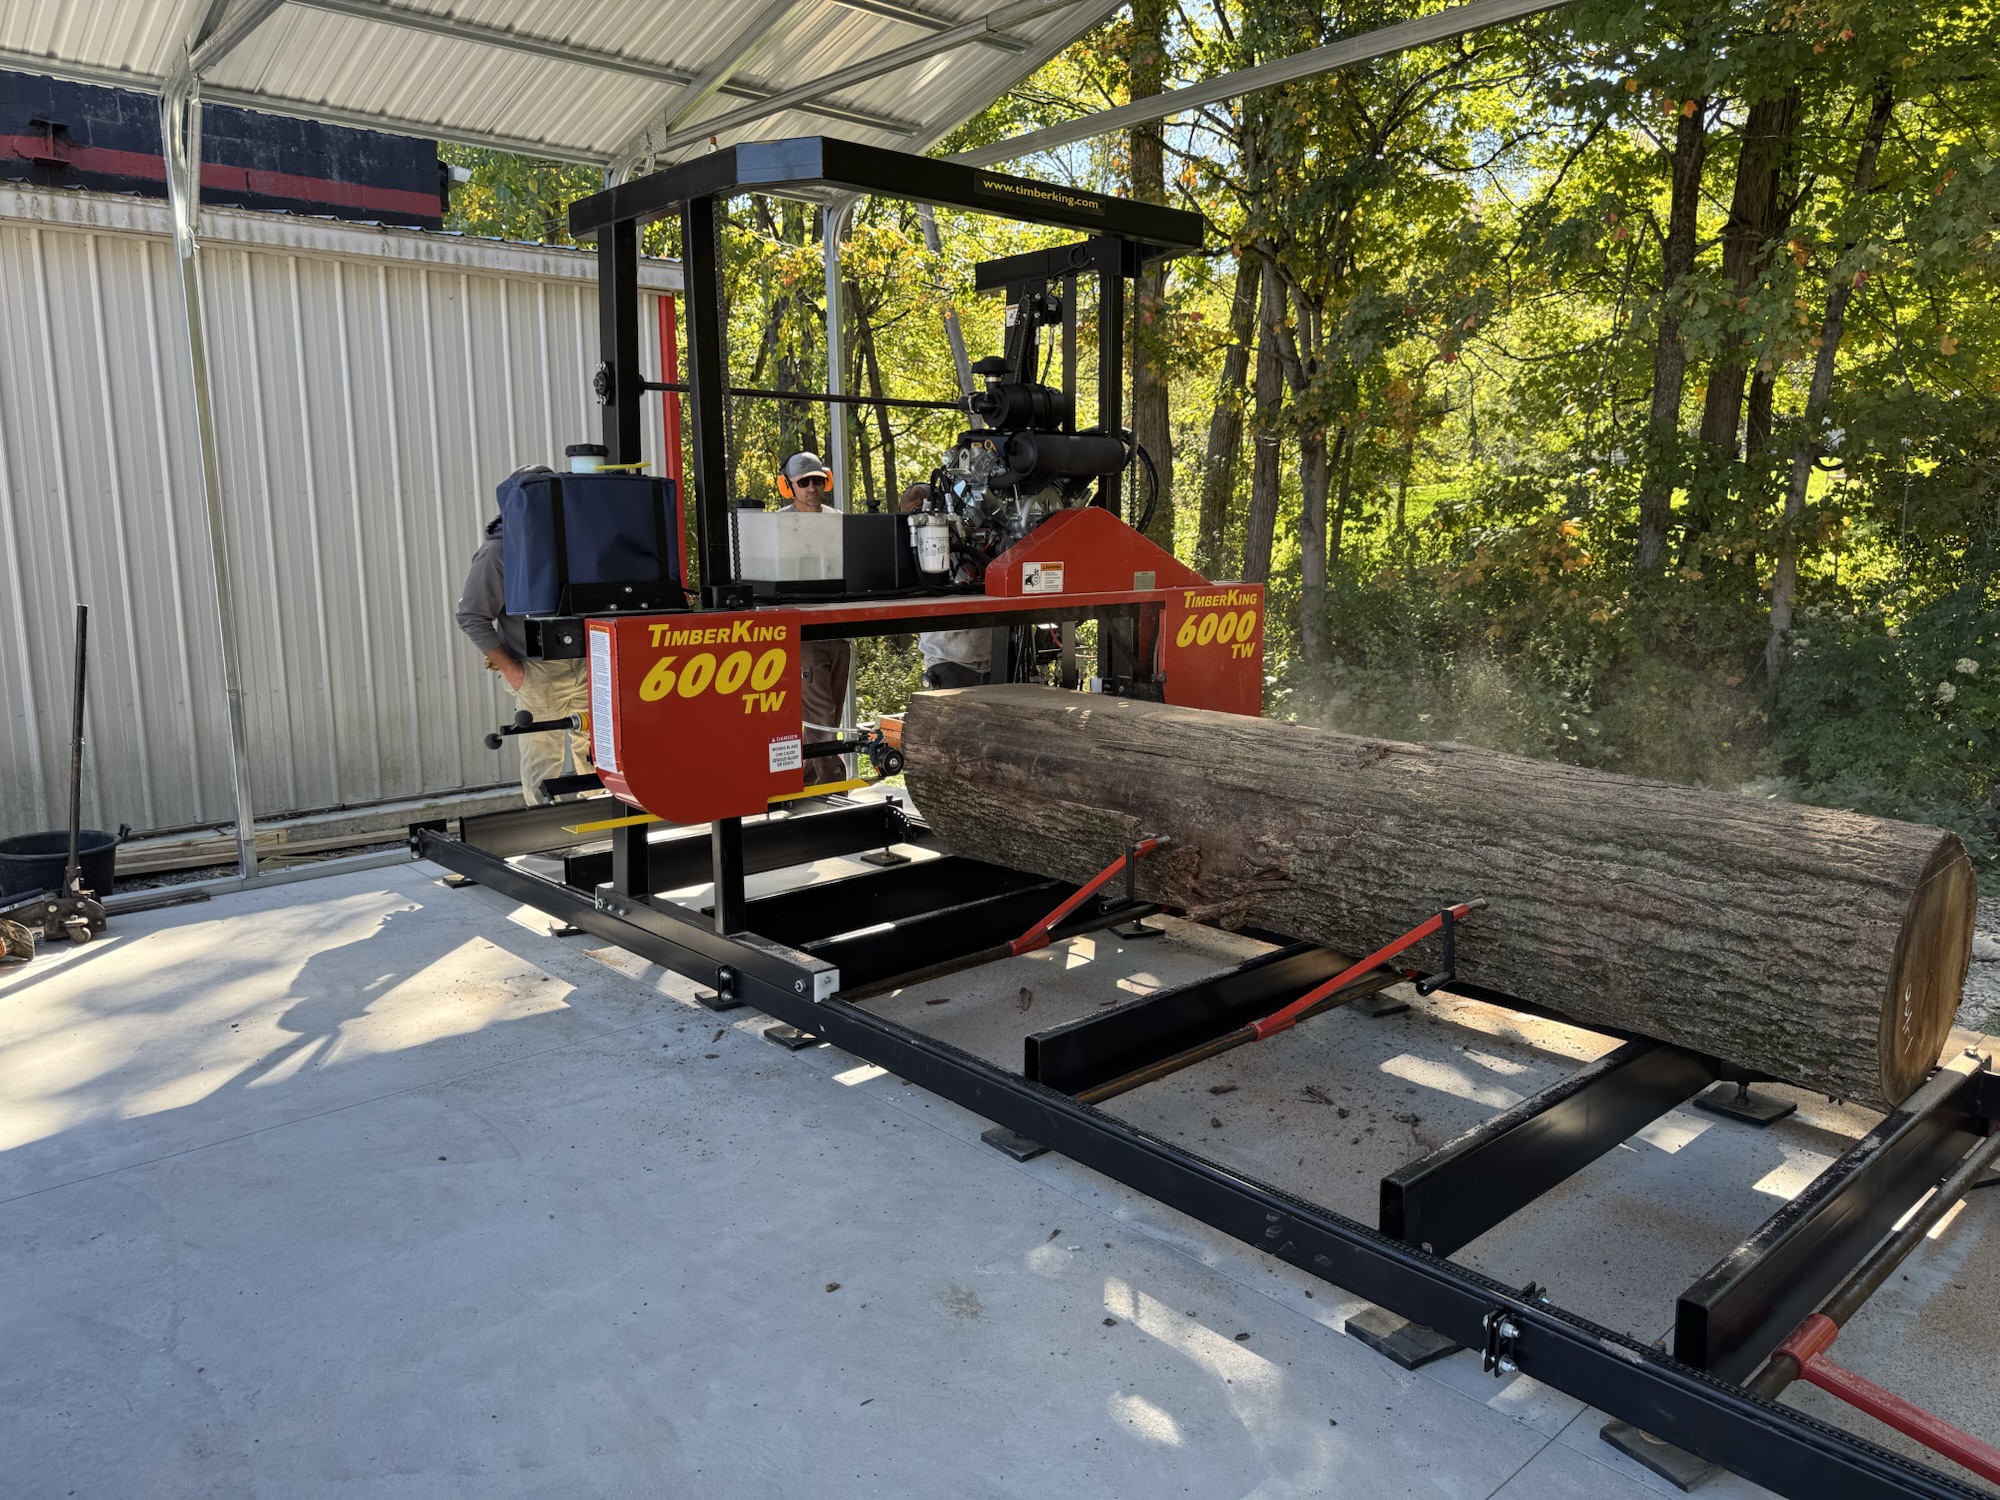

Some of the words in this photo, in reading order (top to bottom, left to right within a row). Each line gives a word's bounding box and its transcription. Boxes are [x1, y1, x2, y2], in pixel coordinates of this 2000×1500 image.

[983, 180, 1099, 209] www.timberking.com
[1176, 610, 1257, 648] 6000
[1231, 642, 1256, 659] TW
[639, 648, 787, 702] 6000
[742, 691, 787, 714] TW
